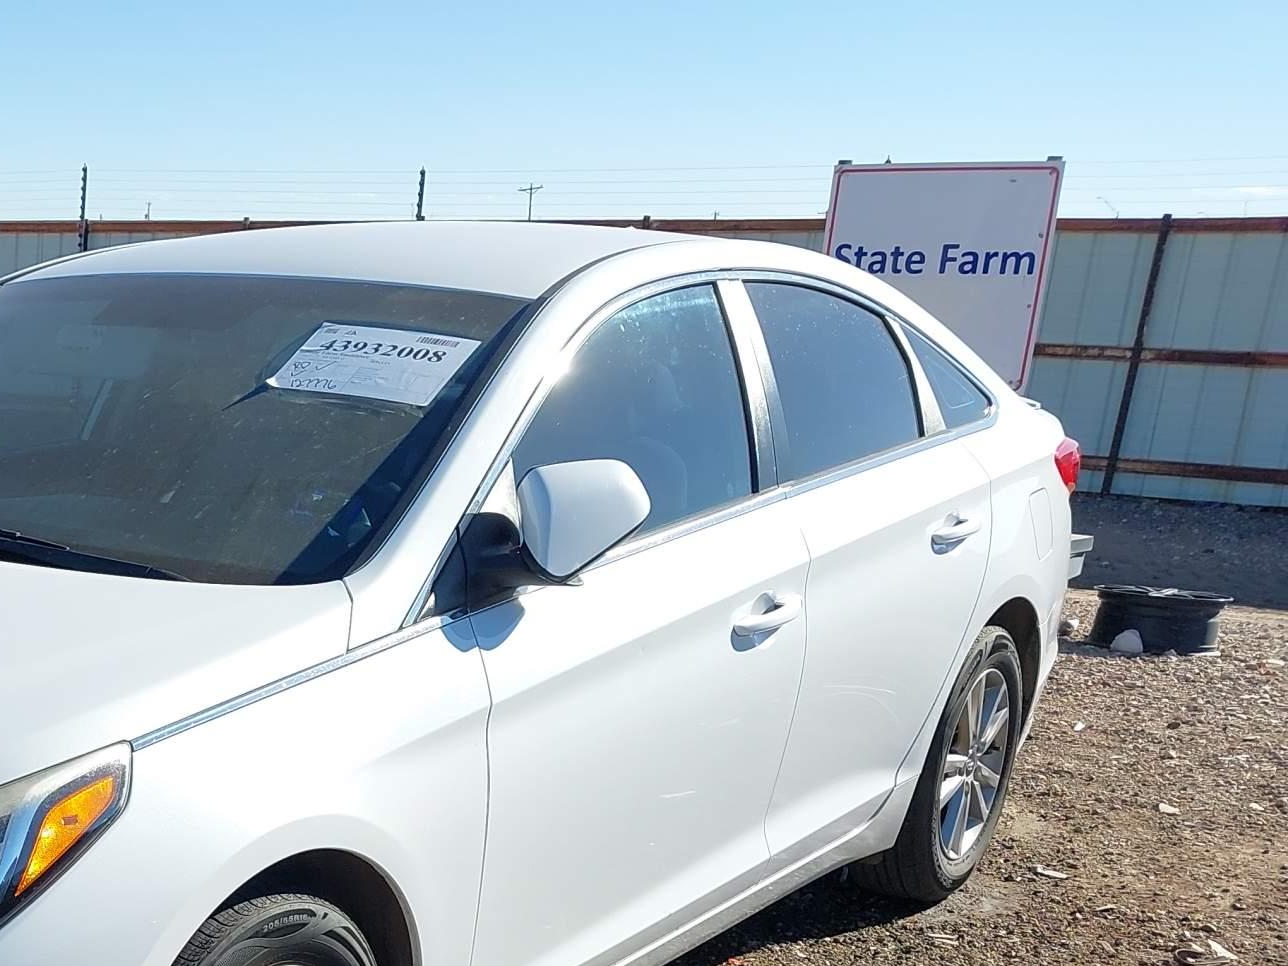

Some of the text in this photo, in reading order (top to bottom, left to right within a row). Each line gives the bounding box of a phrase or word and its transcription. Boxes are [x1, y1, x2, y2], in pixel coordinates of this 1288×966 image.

[834, 243, 1036, 275] State Farm
[319, 339, 447, 363] 43932008
